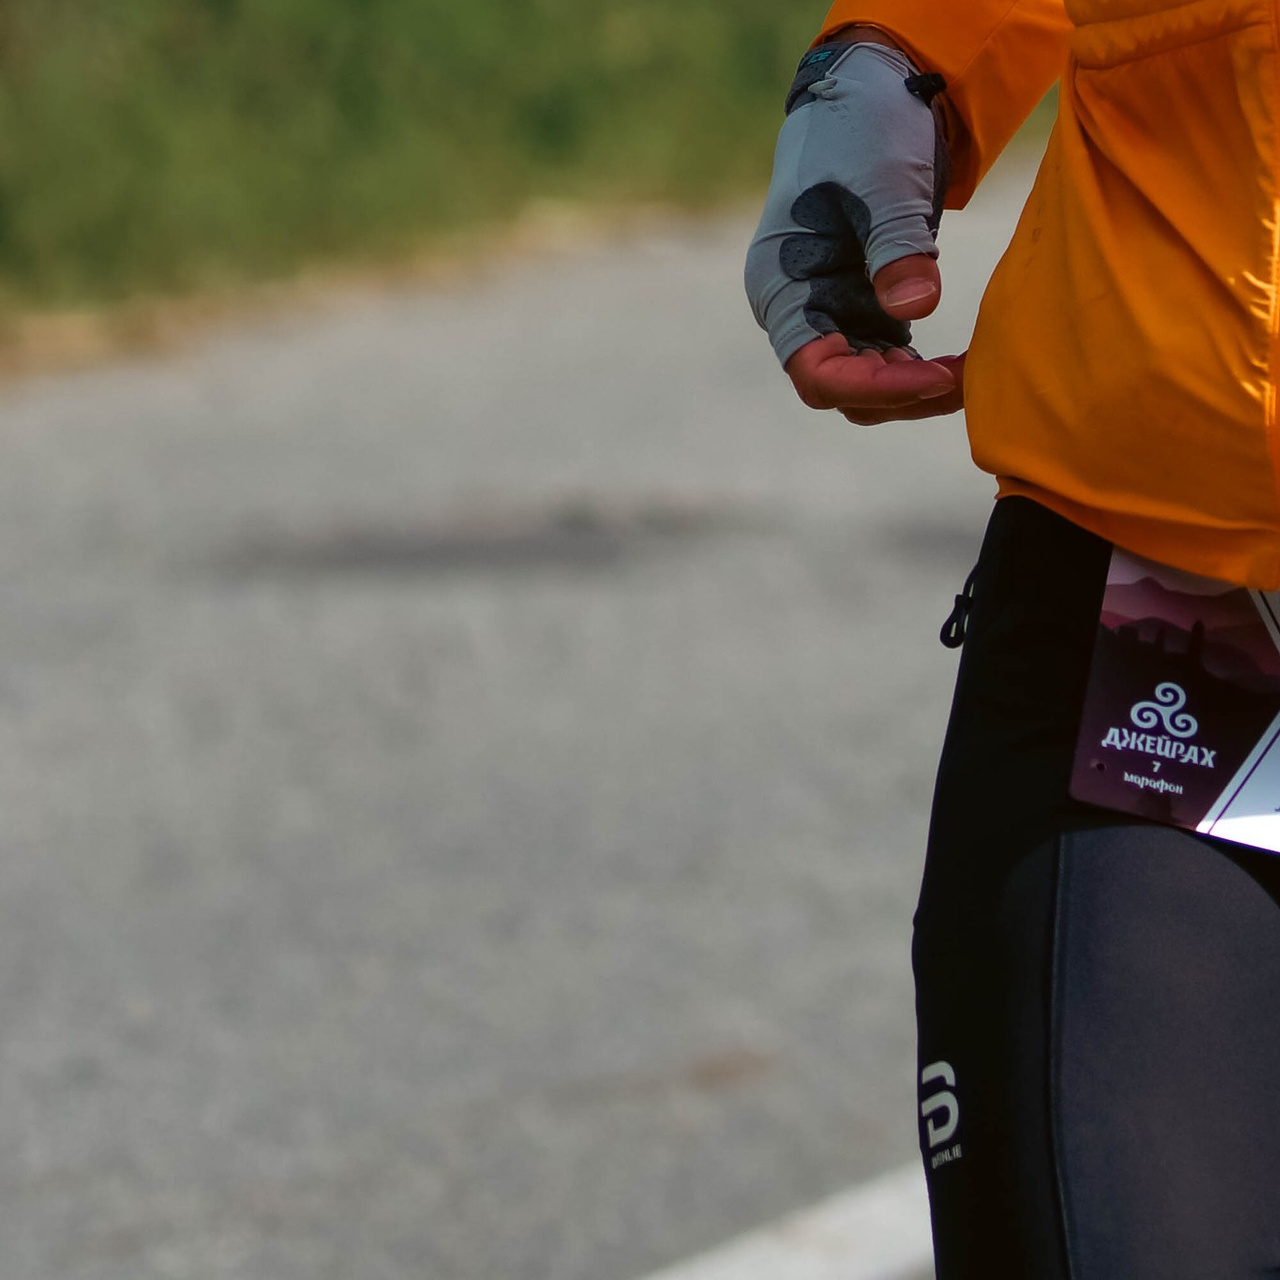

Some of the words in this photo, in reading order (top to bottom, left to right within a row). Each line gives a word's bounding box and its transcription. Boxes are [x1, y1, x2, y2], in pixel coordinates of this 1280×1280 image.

[1101, 726, 1217, 768] ДЖЕЙРАХ
[1152, 760, 1162, 773] 7
[1123, 771, 1184, 795] марафон
